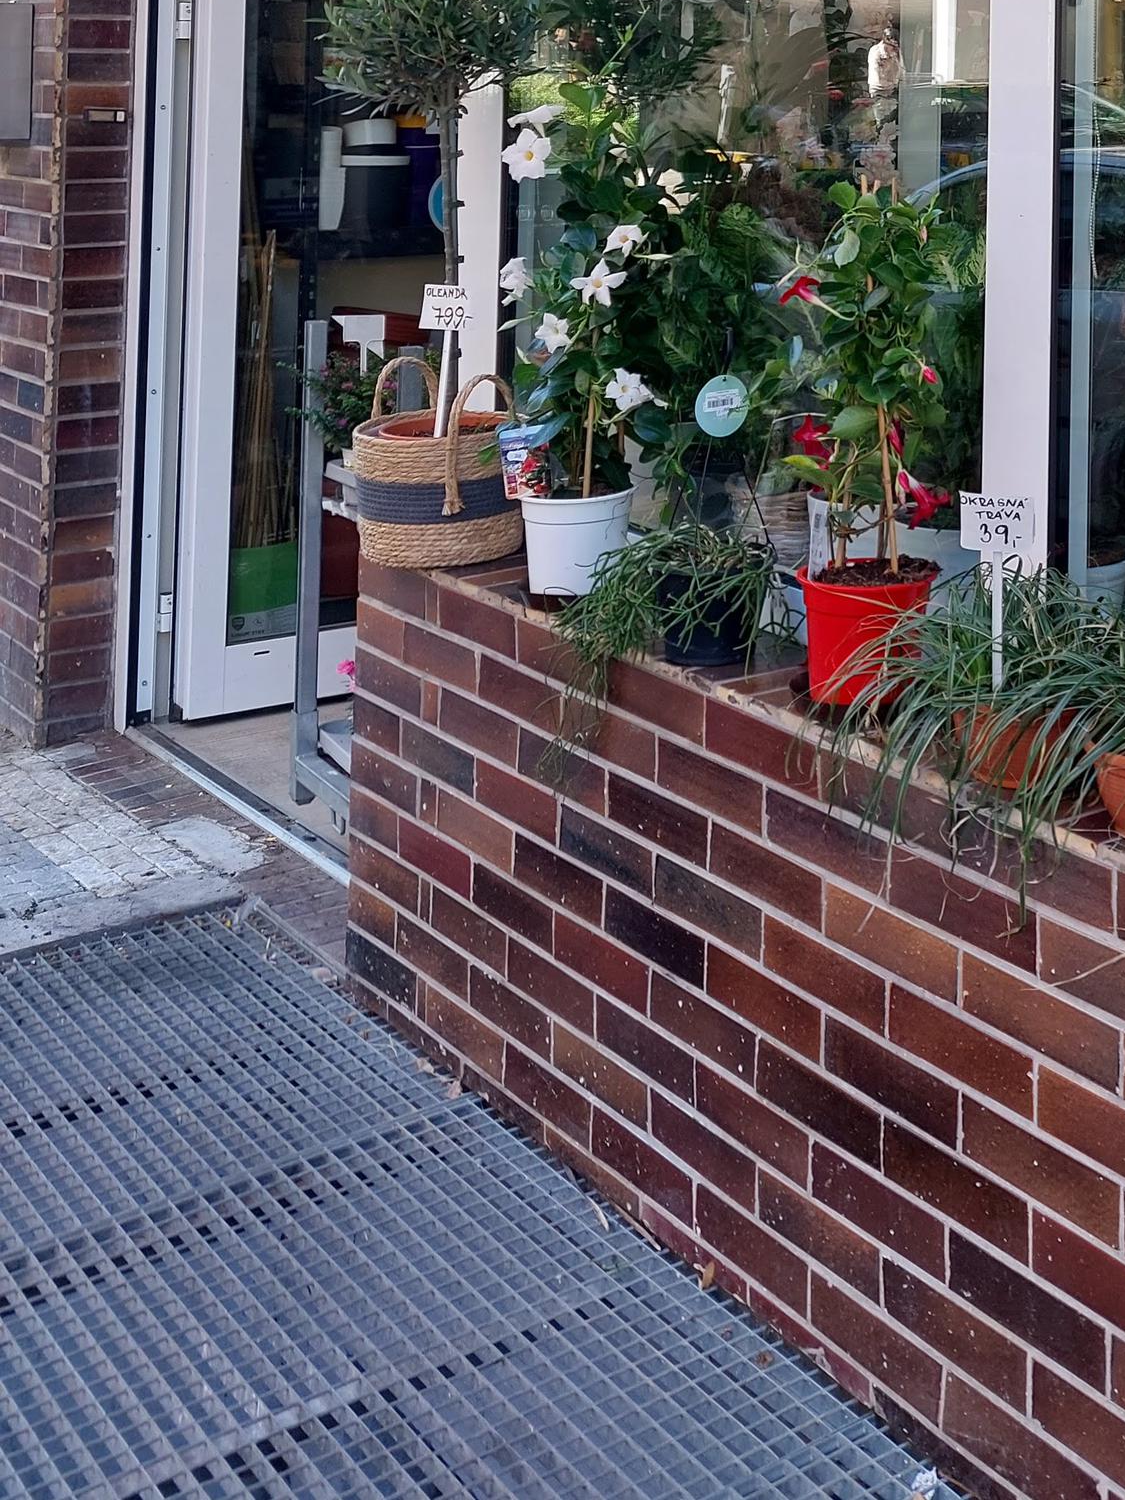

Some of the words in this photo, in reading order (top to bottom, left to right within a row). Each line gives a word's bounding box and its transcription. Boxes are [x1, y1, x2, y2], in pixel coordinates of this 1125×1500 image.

[426, 287, 468, 300] OLEANDR
[960, 495, 1028, 509] OKRASNÁ
[975, 508, 1021, 521] TRÁVA
[980, 523, 1022, 548] 39,-
